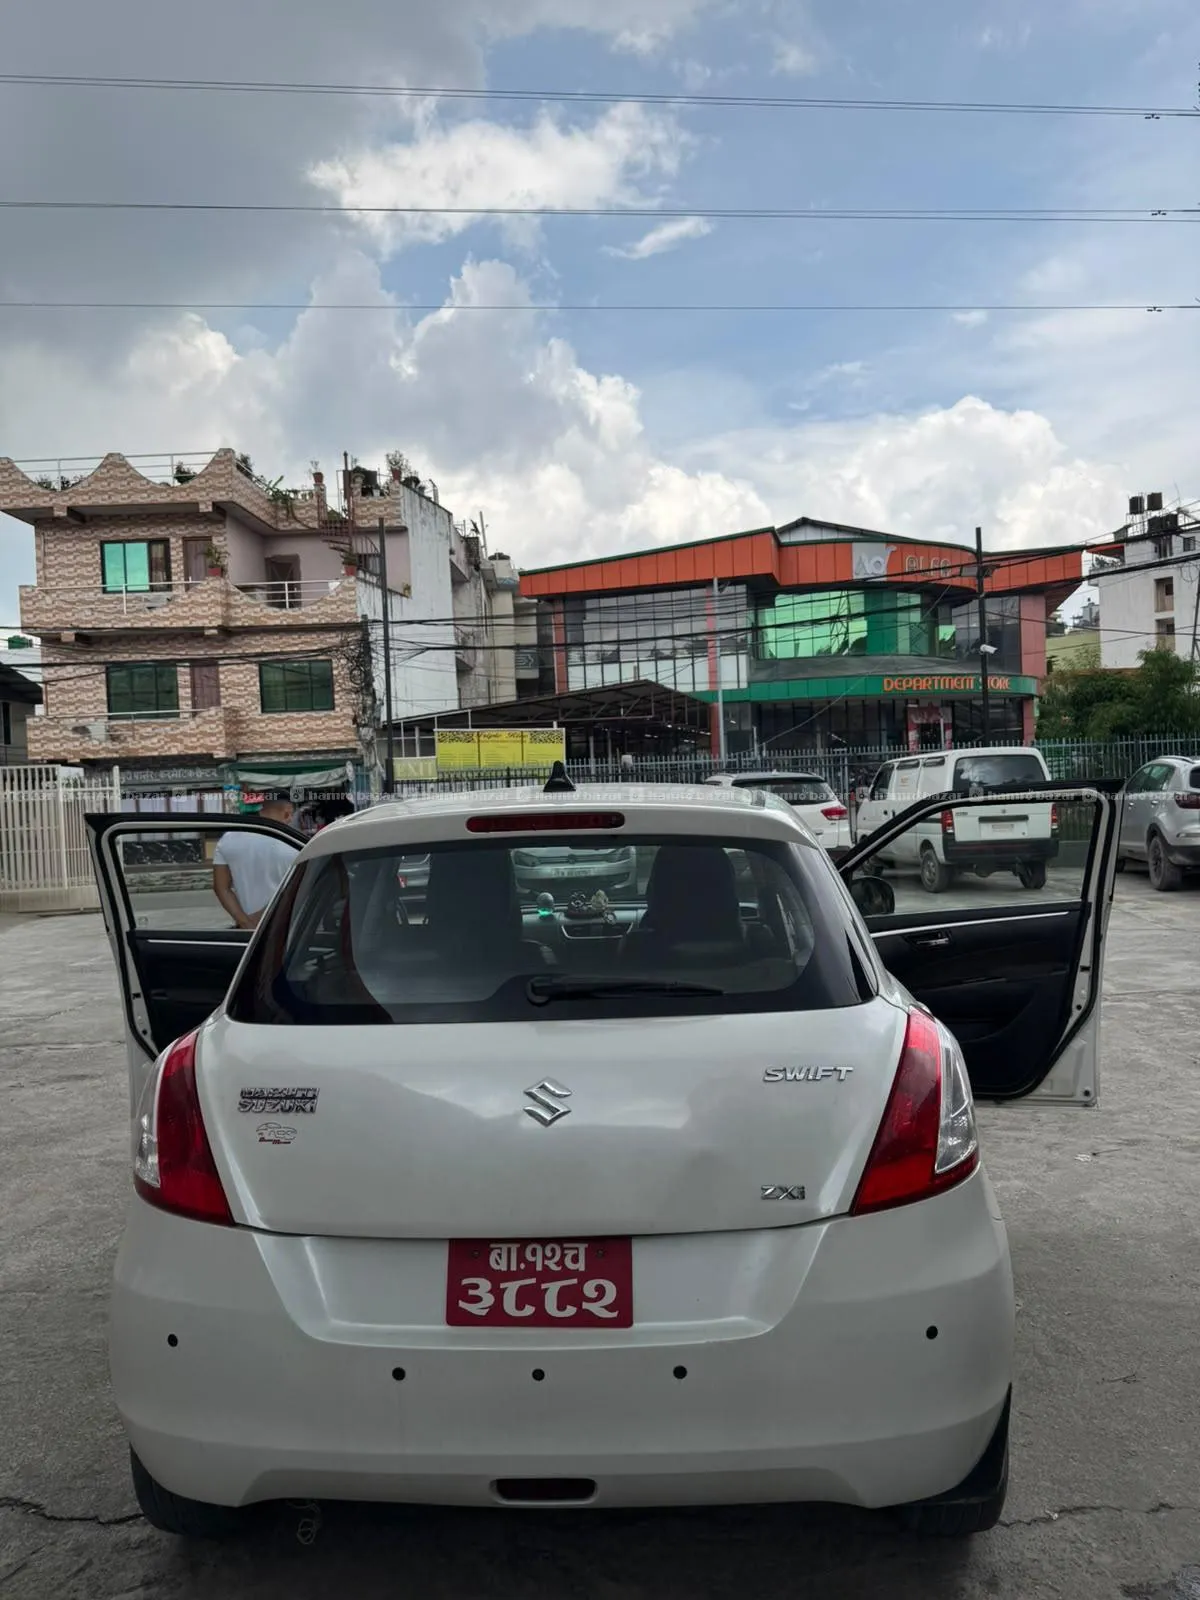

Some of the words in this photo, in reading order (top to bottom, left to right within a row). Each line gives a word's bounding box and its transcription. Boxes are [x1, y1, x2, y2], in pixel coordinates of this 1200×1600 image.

[883, 676, 975, 691] DEPARTMENT
[763, 1066, 854, 1083] SWIFT
[238, 1098, 317, 1113] SUZUKI
[761, 1184, 806, 1201] ZXi
[458, 1277, 619, 1318] ३८८२
